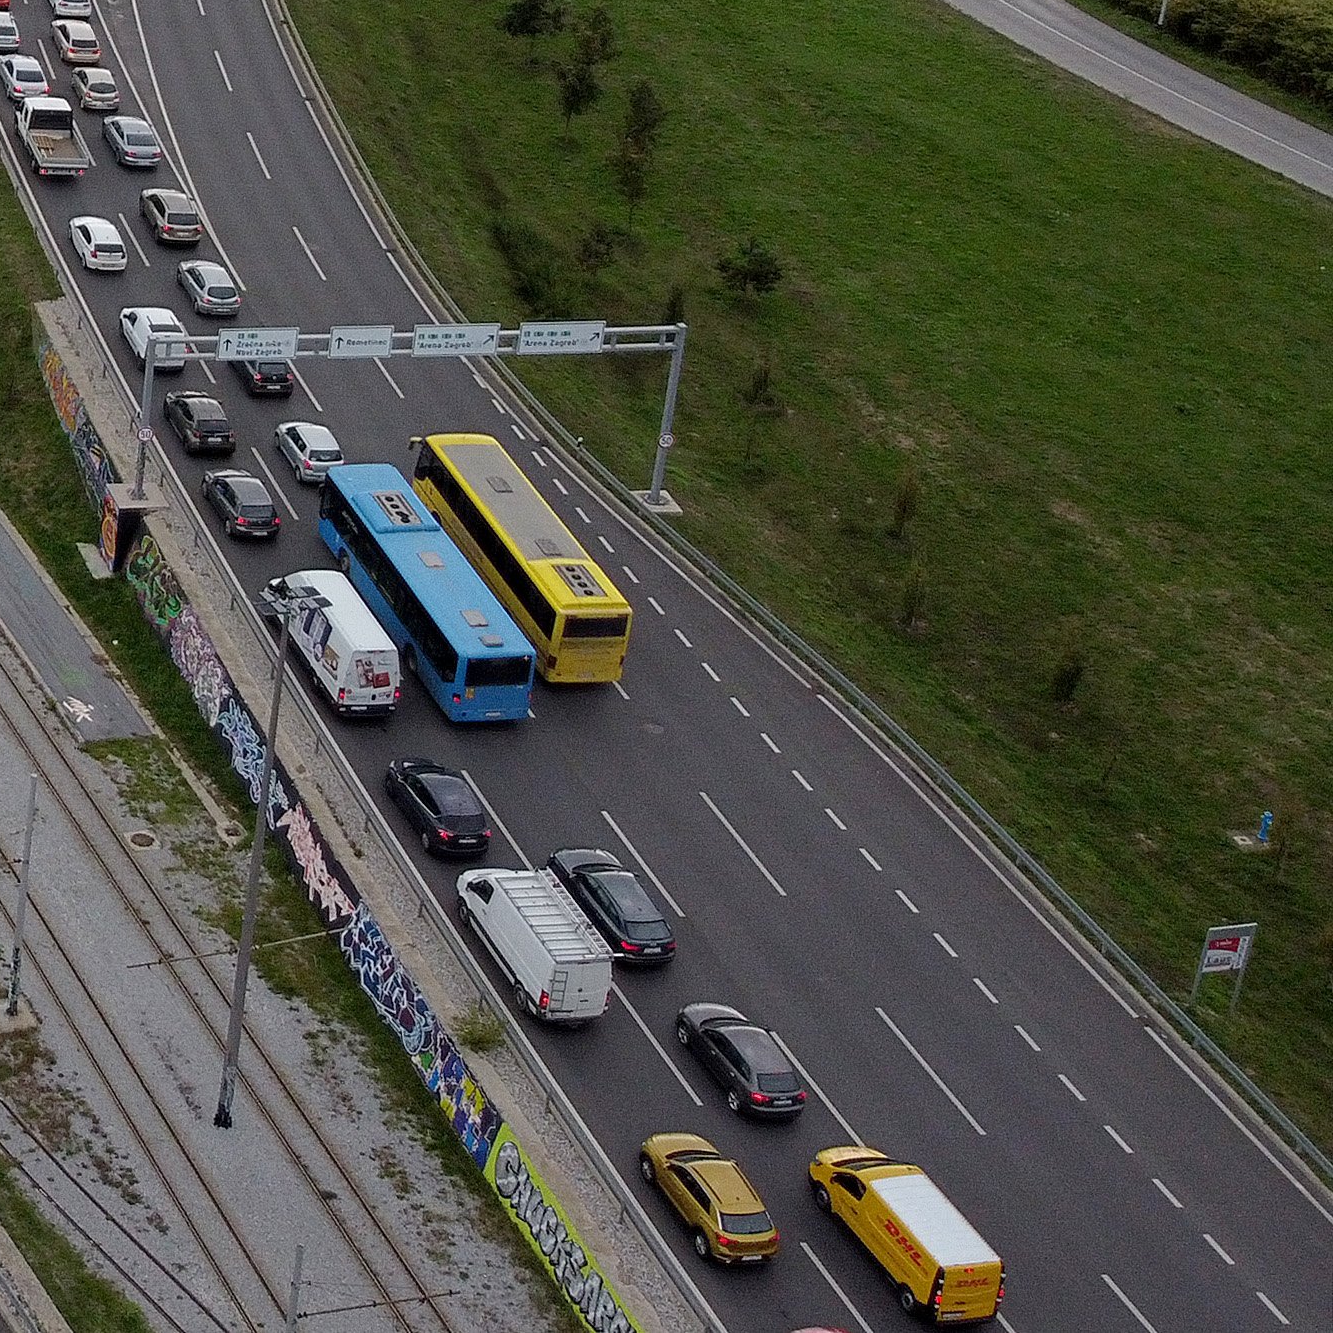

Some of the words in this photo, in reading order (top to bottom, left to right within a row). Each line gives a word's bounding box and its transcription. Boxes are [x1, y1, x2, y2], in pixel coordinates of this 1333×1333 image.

[255, 348, 283, 356] Zagreb
[883, 1218, 923, 1267] DHL
[954, 1277, 990, 1288] DHL
